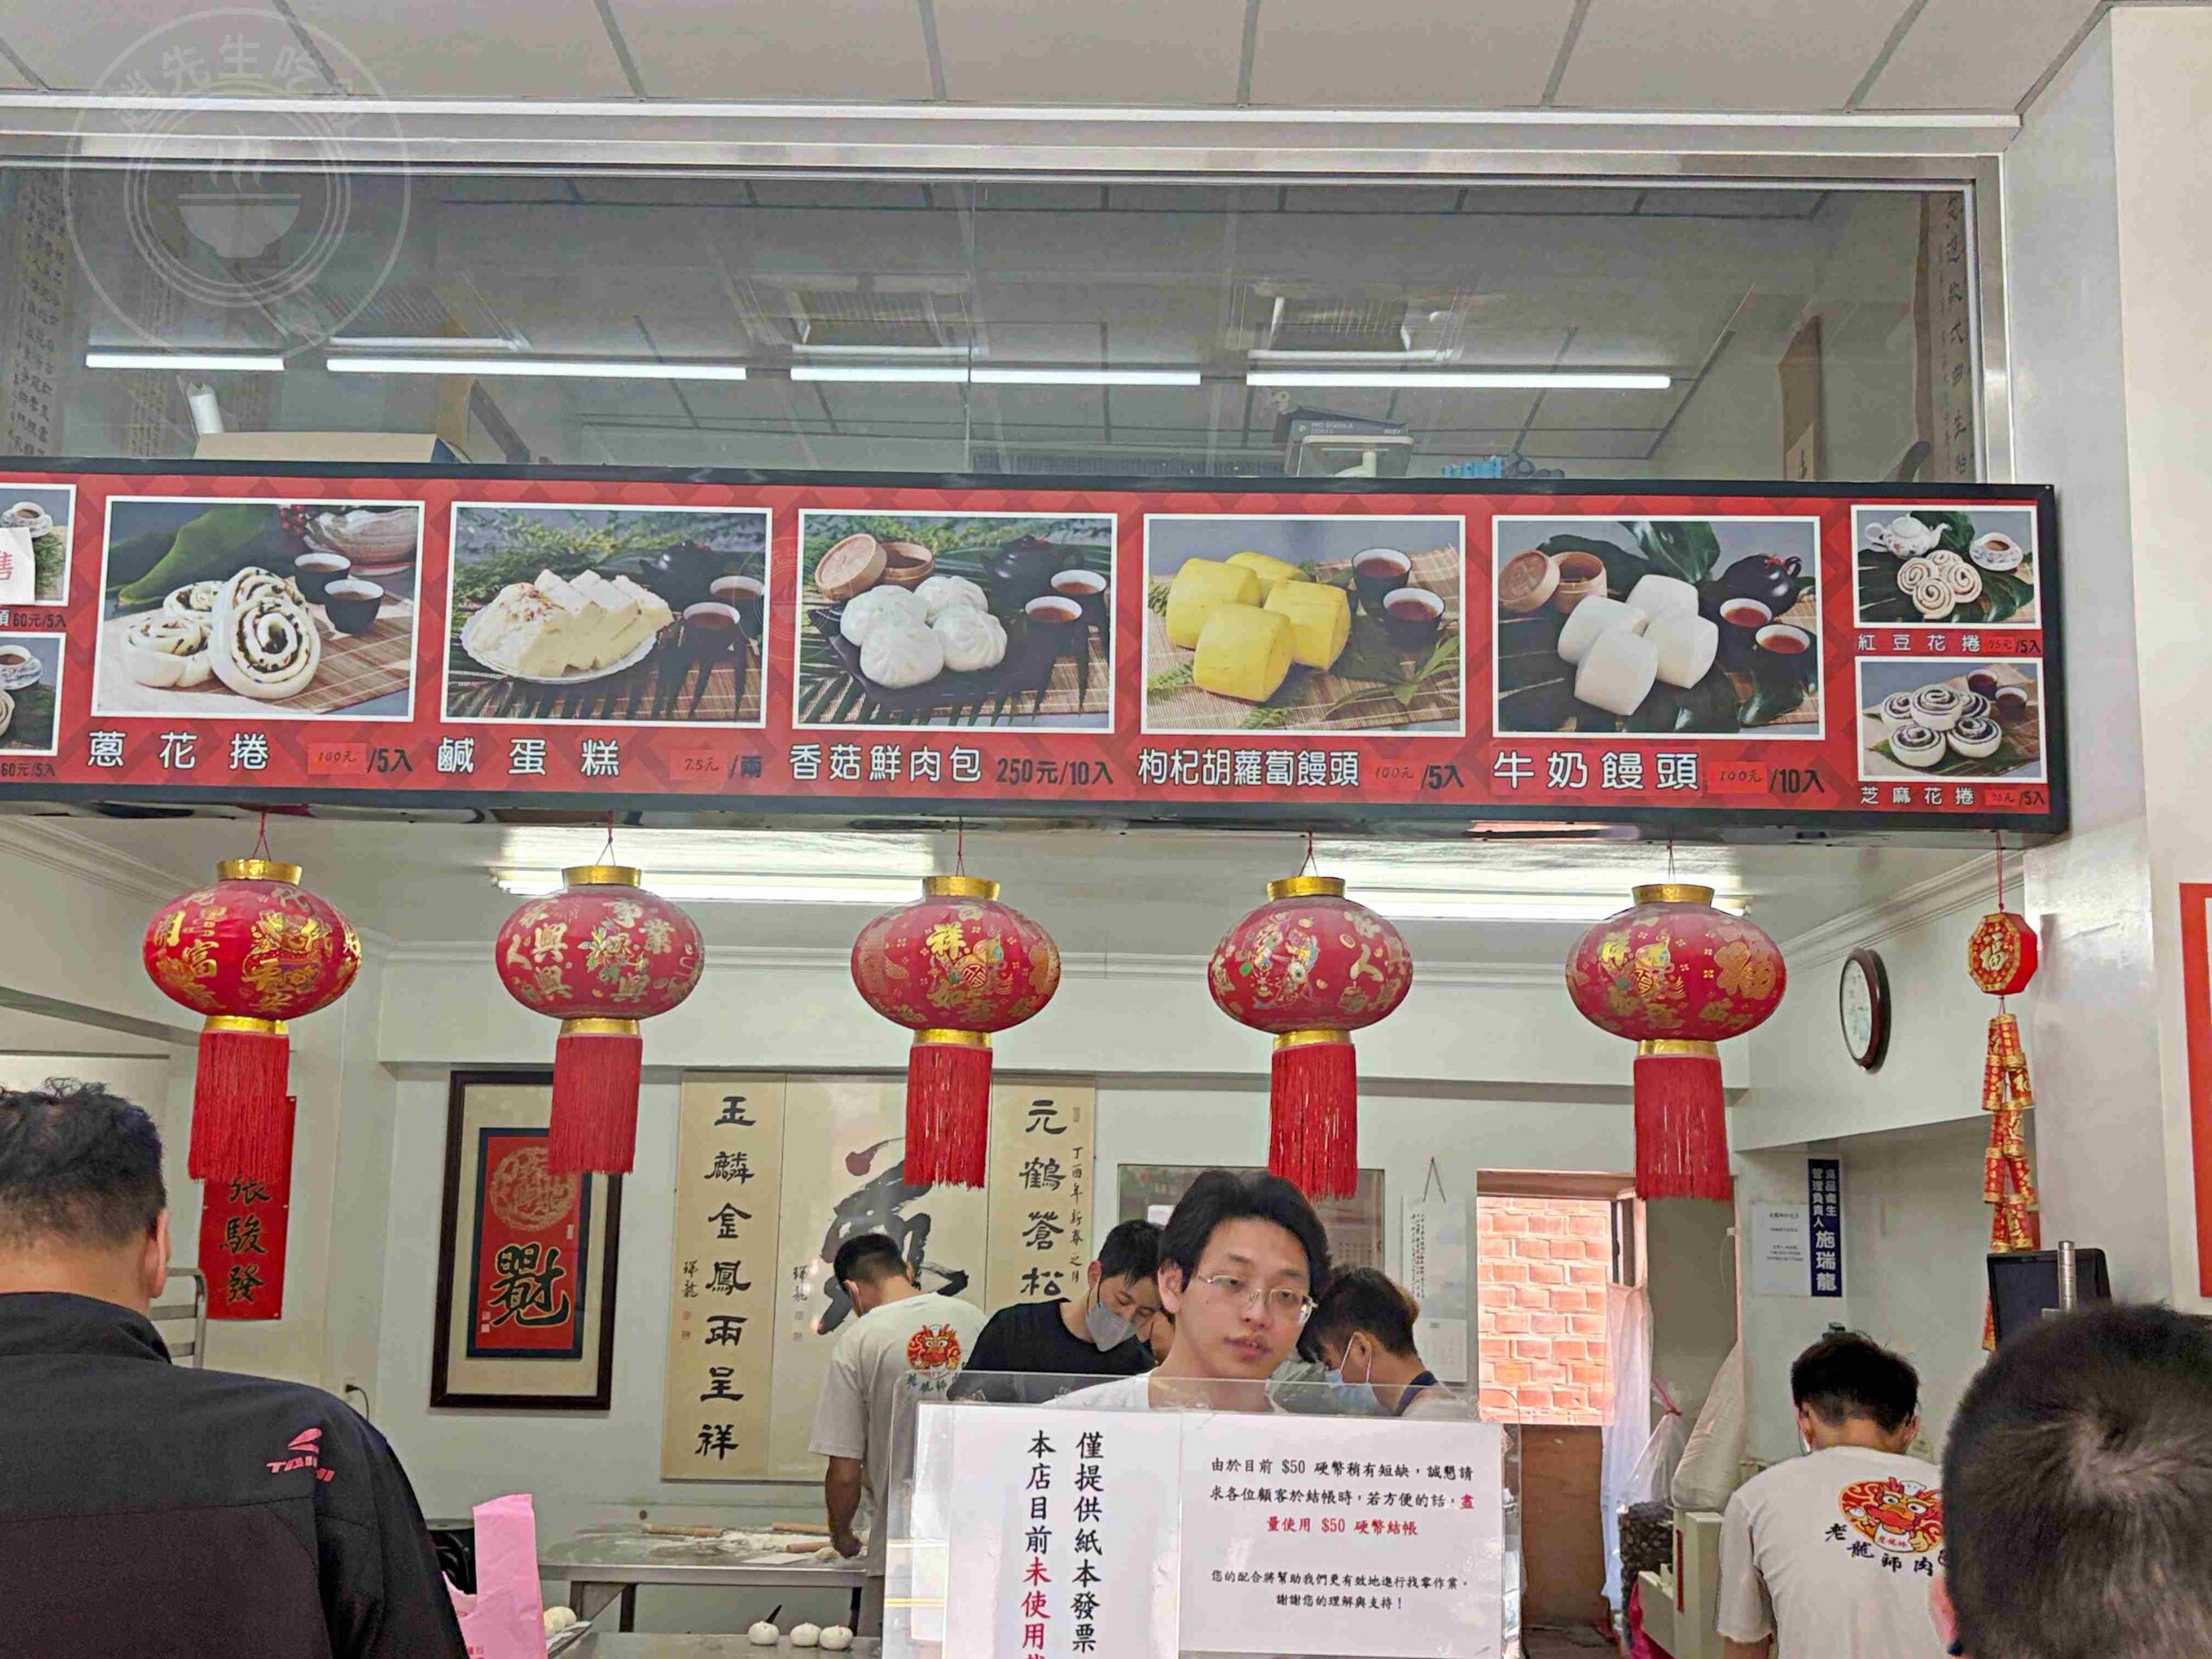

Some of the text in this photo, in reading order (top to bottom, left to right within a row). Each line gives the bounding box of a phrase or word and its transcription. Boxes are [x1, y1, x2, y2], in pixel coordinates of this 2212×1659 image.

[13, 613, 67, 628] 60元/5入
[1858, 633, 1980, 652] 紅豆花捲
[87, 730, 270, 771] 蔥花捲
[435, 735, 620, 777] 鹹蛋糕
[789, 743, 1114, 786] 香菇鮮肉包 250元/10入
[1137, 747, 1360, 788] 枸杞胡蘿蔔饅頭
[1492, 750, 1700, 791] 牛奶饅頭
[1860, 786, 1974, 805] 芝麻花捲
[1815, 1230, 1837, 1291] 施瑞龍
[1211, 1457, 1273, 1475] 由於目前
[1281, 1459, 1306, 1475] $50
[1021, 1429, 1057, 1659] 本店目前未使用
[1070, 1431, 1104, 1653] 僅提供紙本發票
[1267, 1515, 1419, 1536] 量使用 $50 硬幣結帳
